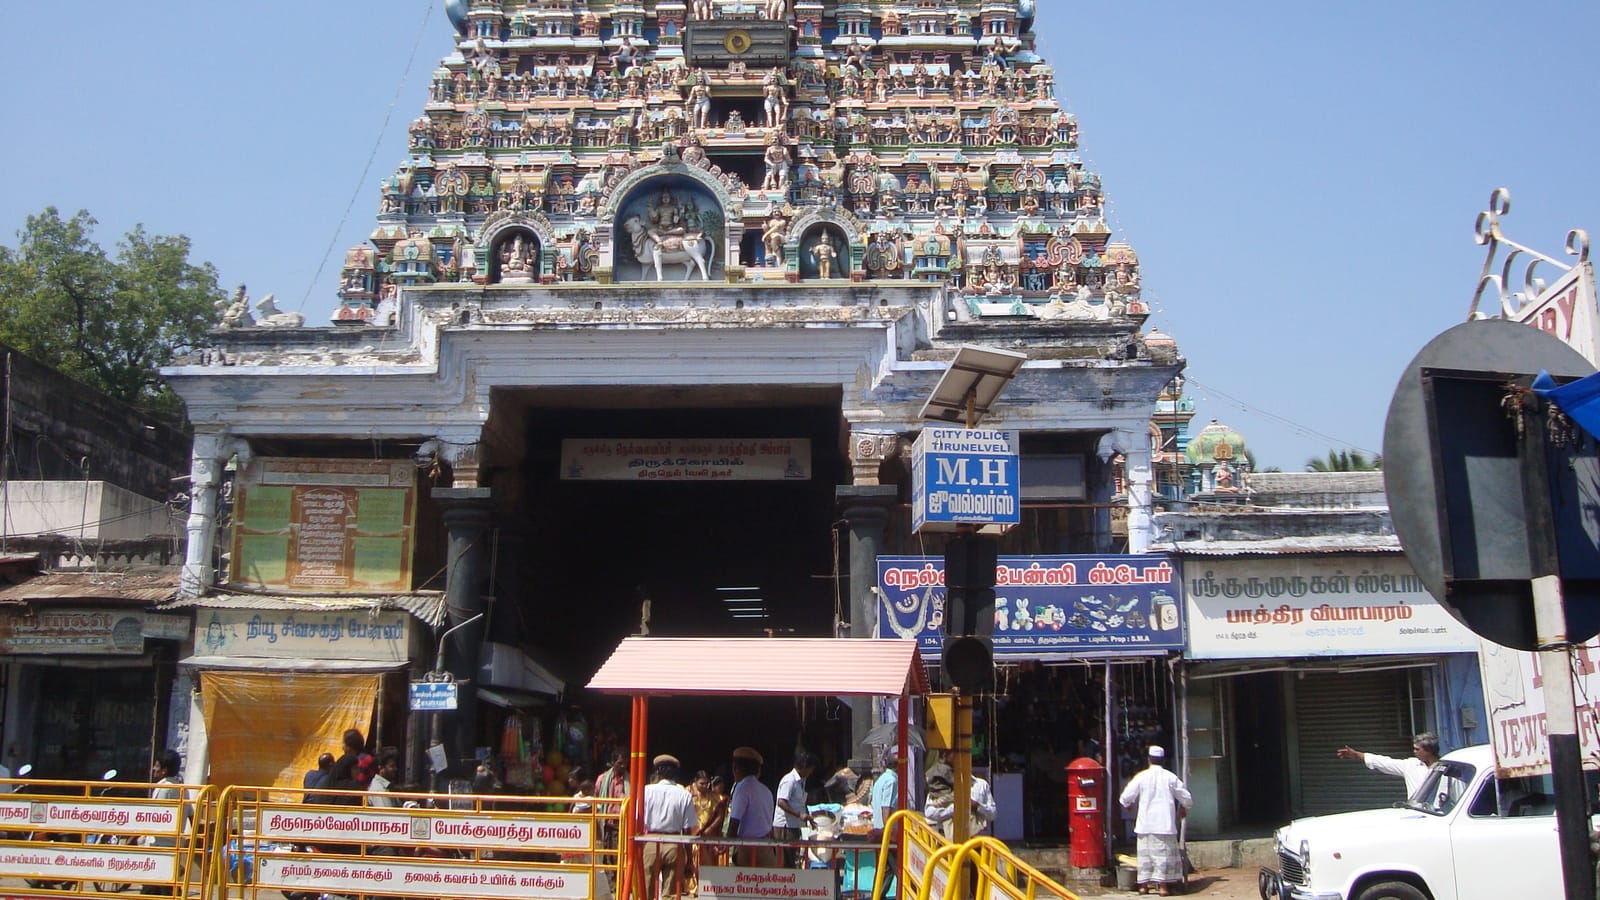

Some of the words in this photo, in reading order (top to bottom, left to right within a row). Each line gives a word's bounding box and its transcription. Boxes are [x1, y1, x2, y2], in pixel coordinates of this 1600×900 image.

[933, 430, 962, 439] CITY
[966, 431, 1010, 440] POLICE
[931, 441, 1011, 452] TIRUNELVELI
[935, 457, 1009, 486] M.H
[1089, 561, 1173, 585] ஸ்டோர்
[1226, 603, 1305, 625] பாத்திர
[1310, 600, 1413, 623] வியாபாரம்
[246, 613, 278, 643] நியூ
[281, 615, 345, 643] சிவசக்தி
[49, 806, 131, 825] போக்குவரத்து
[135, 810, 173, 824] காவல்
[434, 822, 534, 843] போக்குவரத்து
[536, 825, 583, 841] காவல்
[54, 855, 105, 868] இடங்களில்
[108, 856, 157, 871] நிறுத்தாதீர்
[281, 864, 312, 878] தர்மம்
[312, 865, 350, 879] தலைக்
[351, 866, 393, 881] காக்கும்
[404, 870, 443, 884] தலைக்
[444, 871, 478, 884] கவசம்
[520, 873, 565, 889] காக்கும்
[735, 872, 796, 883] திருநெல்வேலி
[702, 884, 735, 895] மாநகர
[736, 884, 798, 898] போக்குவரத்து
[799, 886, 829, 897] காவல்
